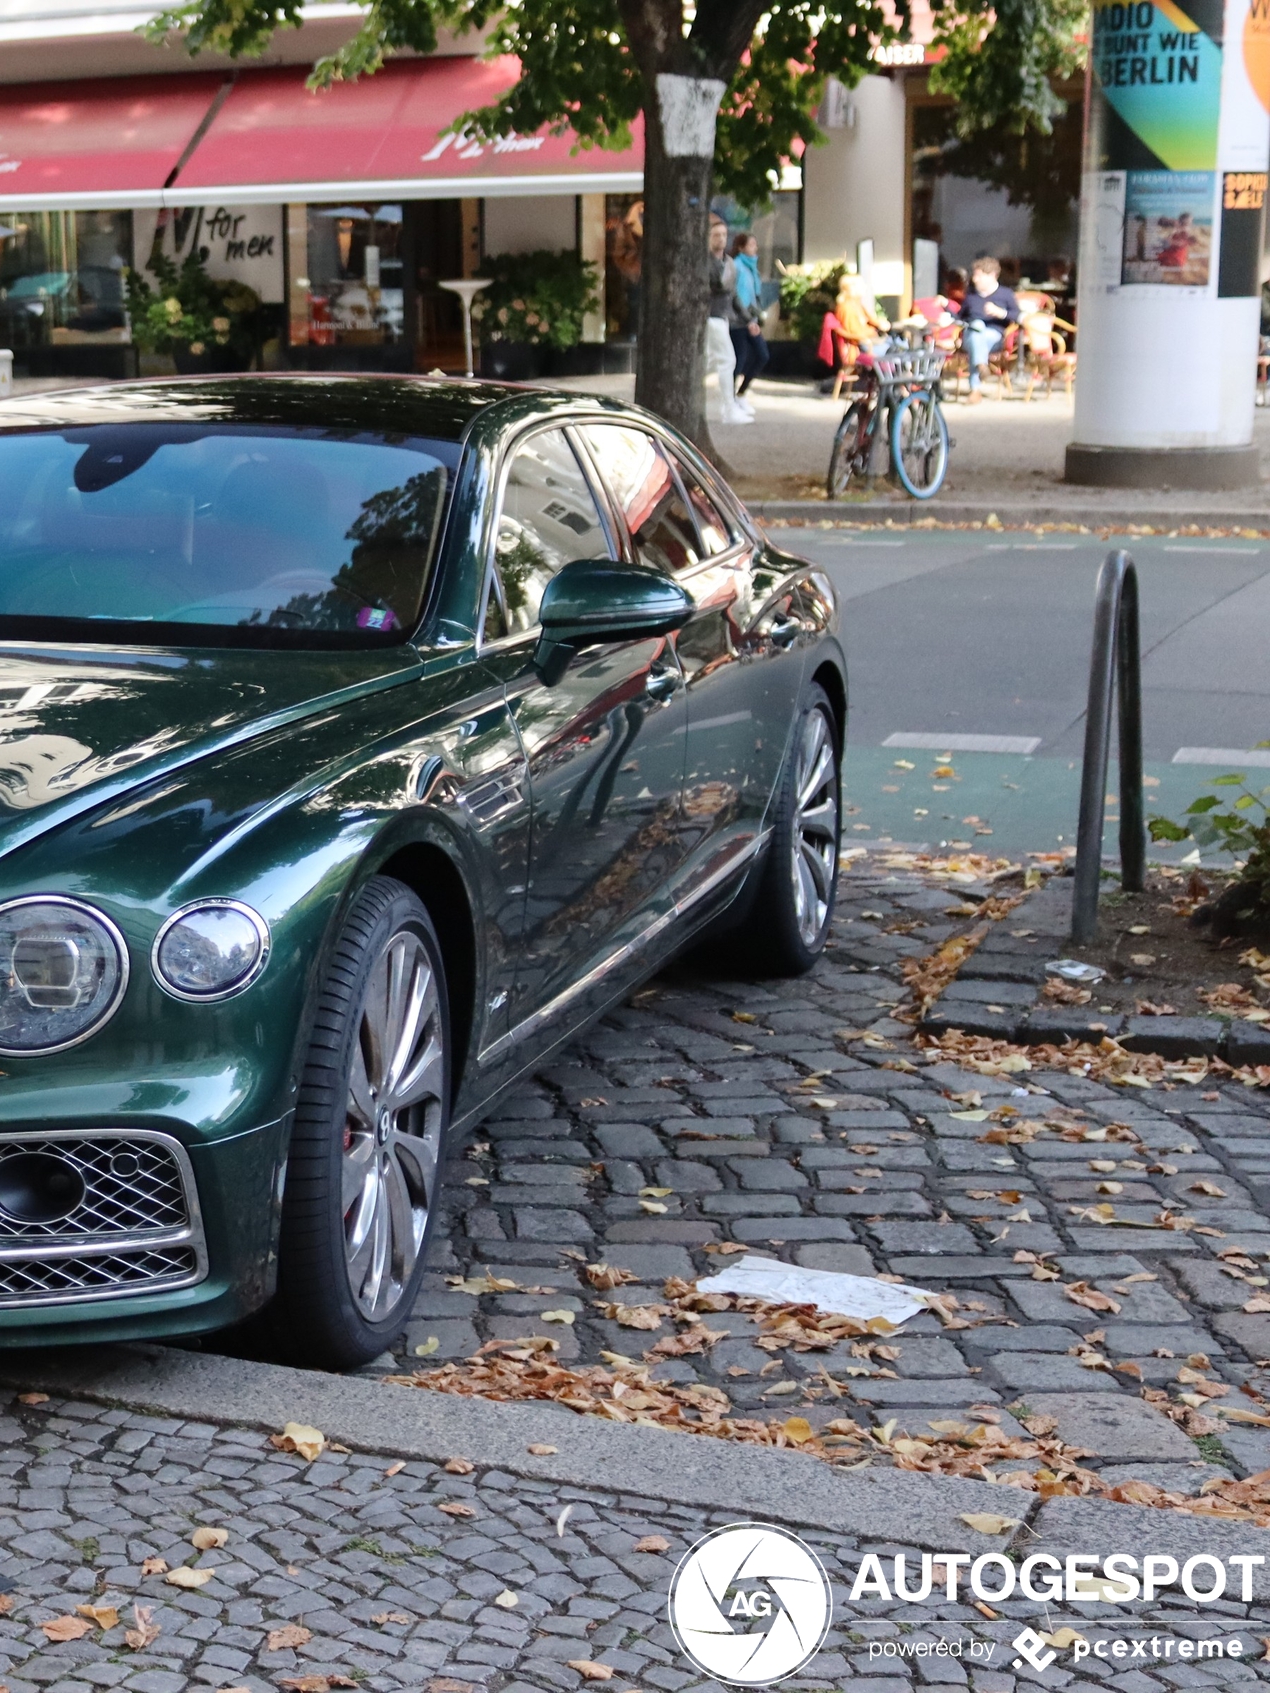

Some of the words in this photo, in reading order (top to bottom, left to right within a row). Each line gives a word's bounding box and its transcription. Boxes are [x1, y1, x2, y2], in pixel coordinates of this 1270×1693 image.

[1094, 1, 1154, 32] ADIO
[867, 44, 925, 65] AISER
[1159, 31, 1200, 51] WIE
[1102, 55, 1200, 87] BERLIN
[206, 206, 247, 241] for
[226, 235, 274, 262] men
